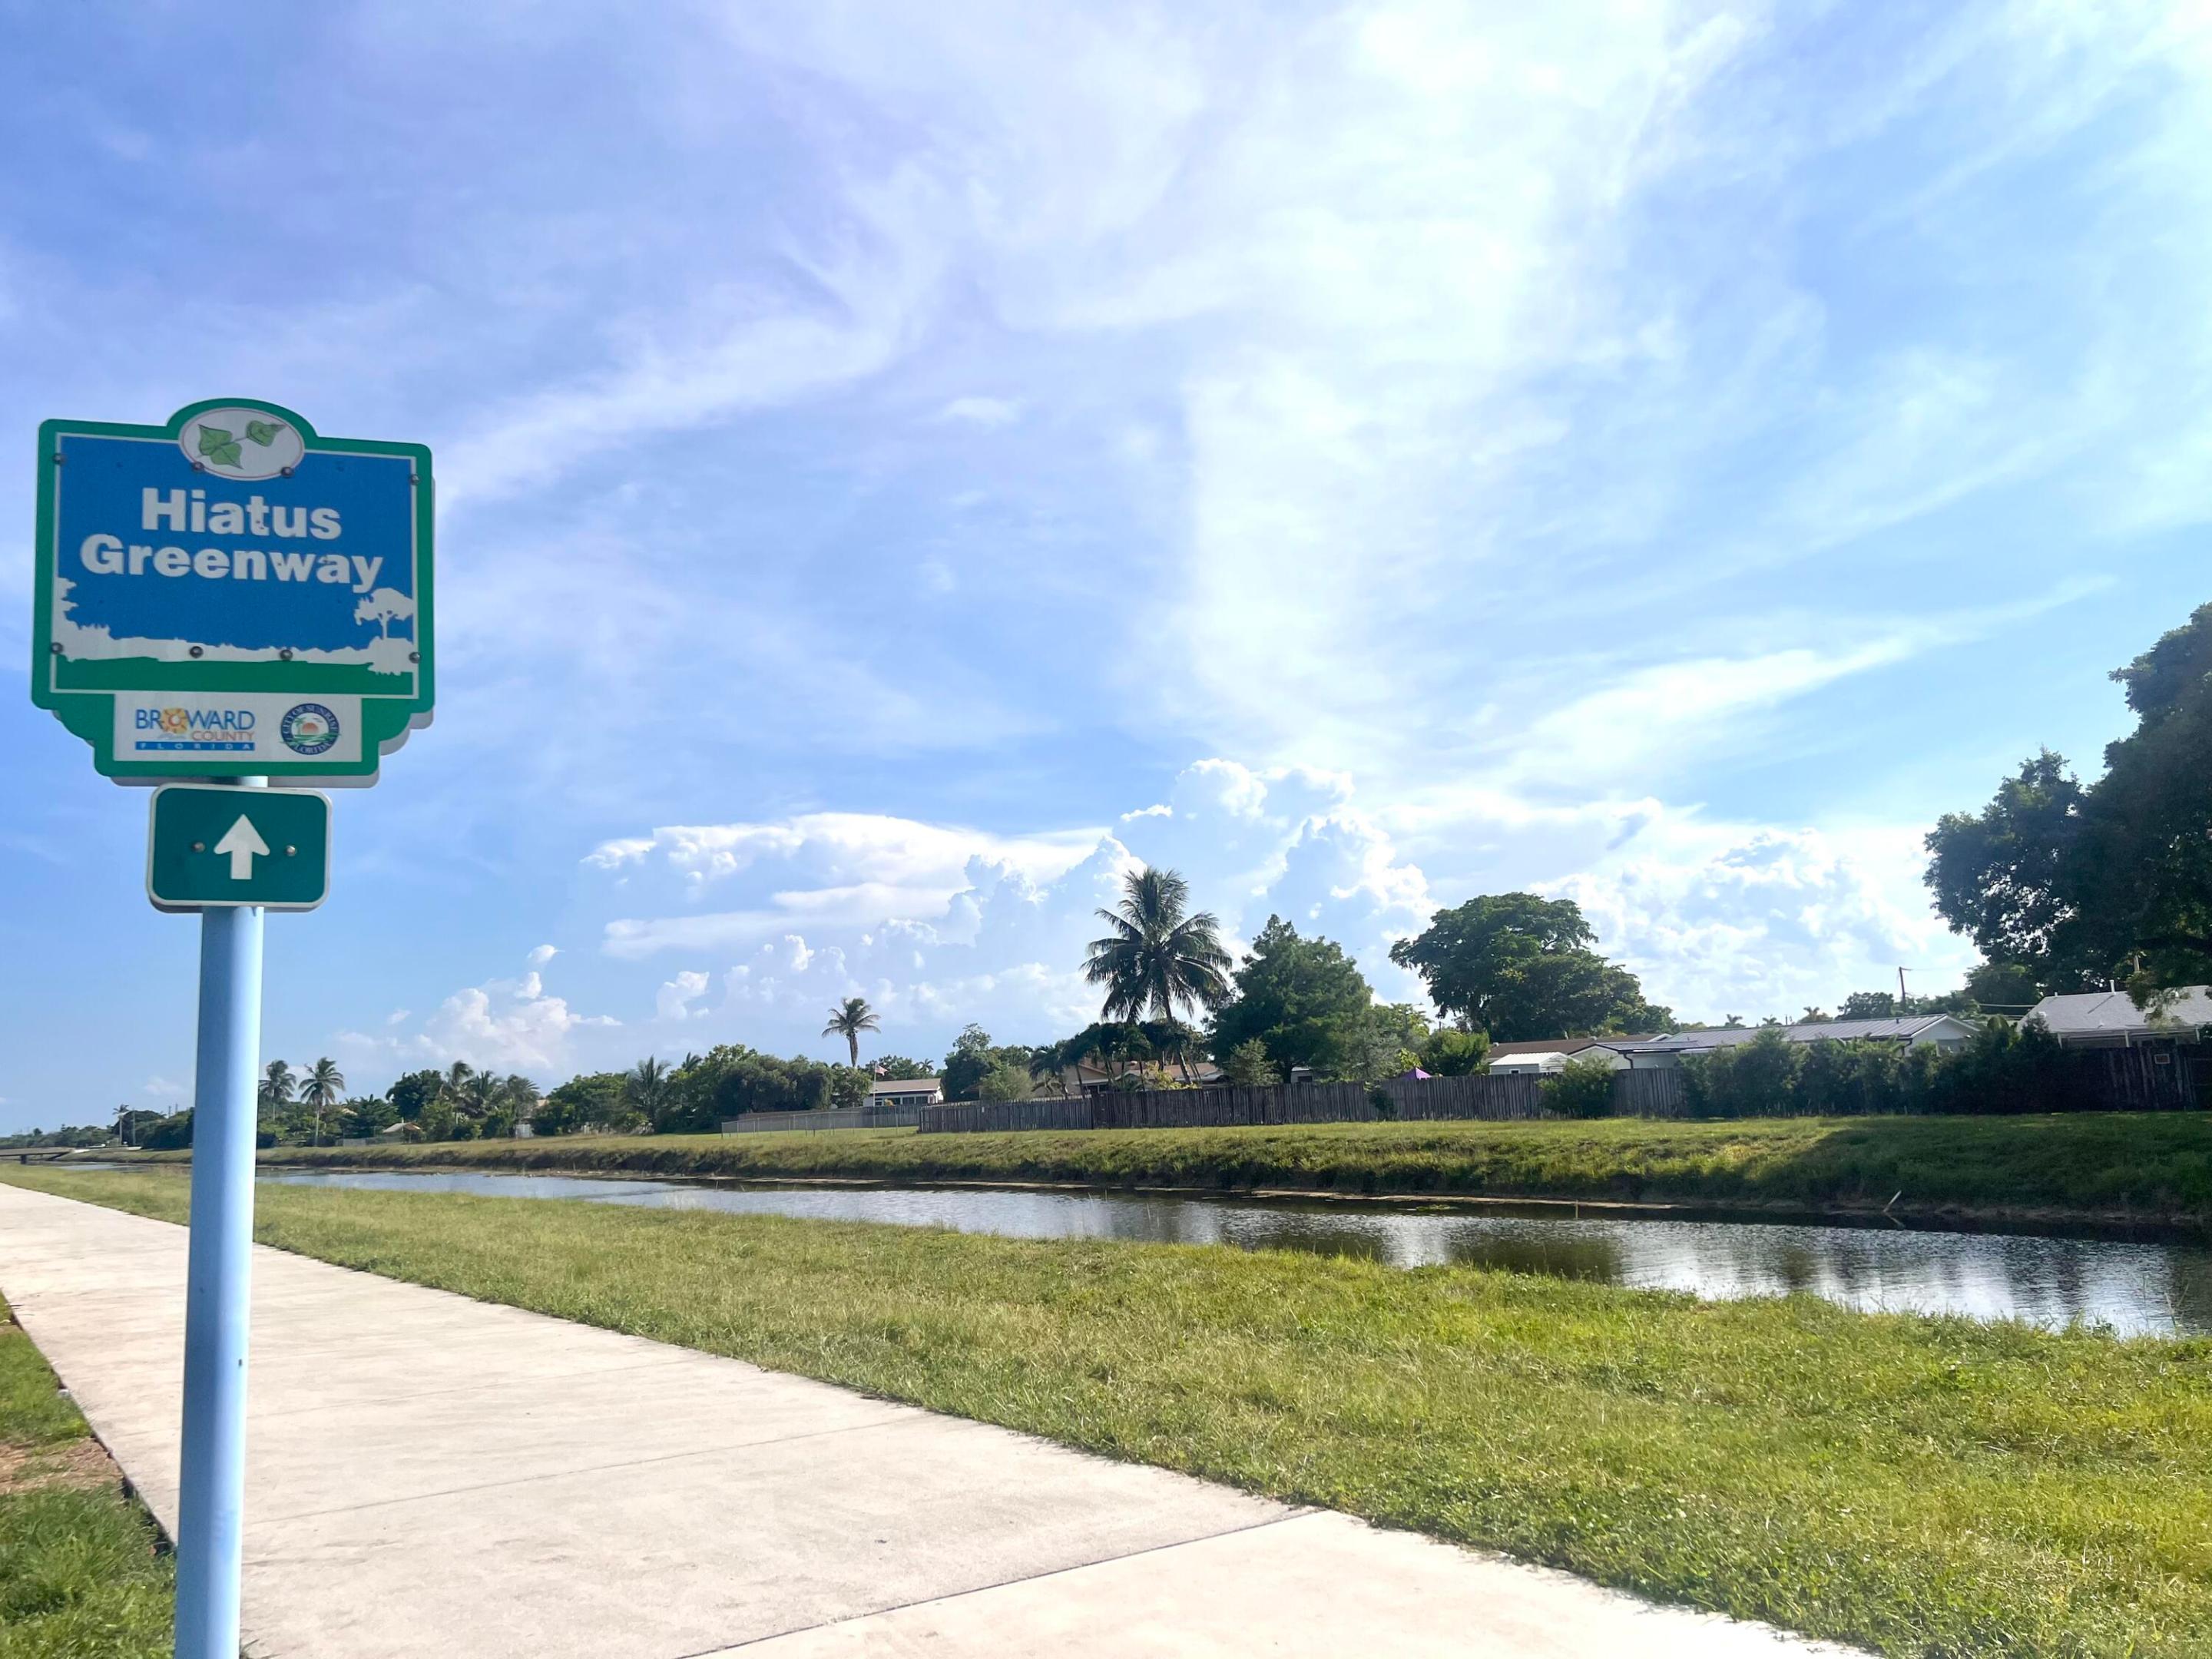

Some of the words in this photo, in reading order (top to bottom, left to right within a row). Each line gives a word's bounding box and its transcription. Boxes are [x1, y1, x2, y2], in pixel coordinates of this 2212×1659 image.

[141, 487, 343, 540] Hiatus
[80, 533, 383, 593] Greenway
[135, 708, 256, 730] BROWARD
[139, 742, 252, 751] FLORIDA
[190, 730, 256, 742] COUNTY
